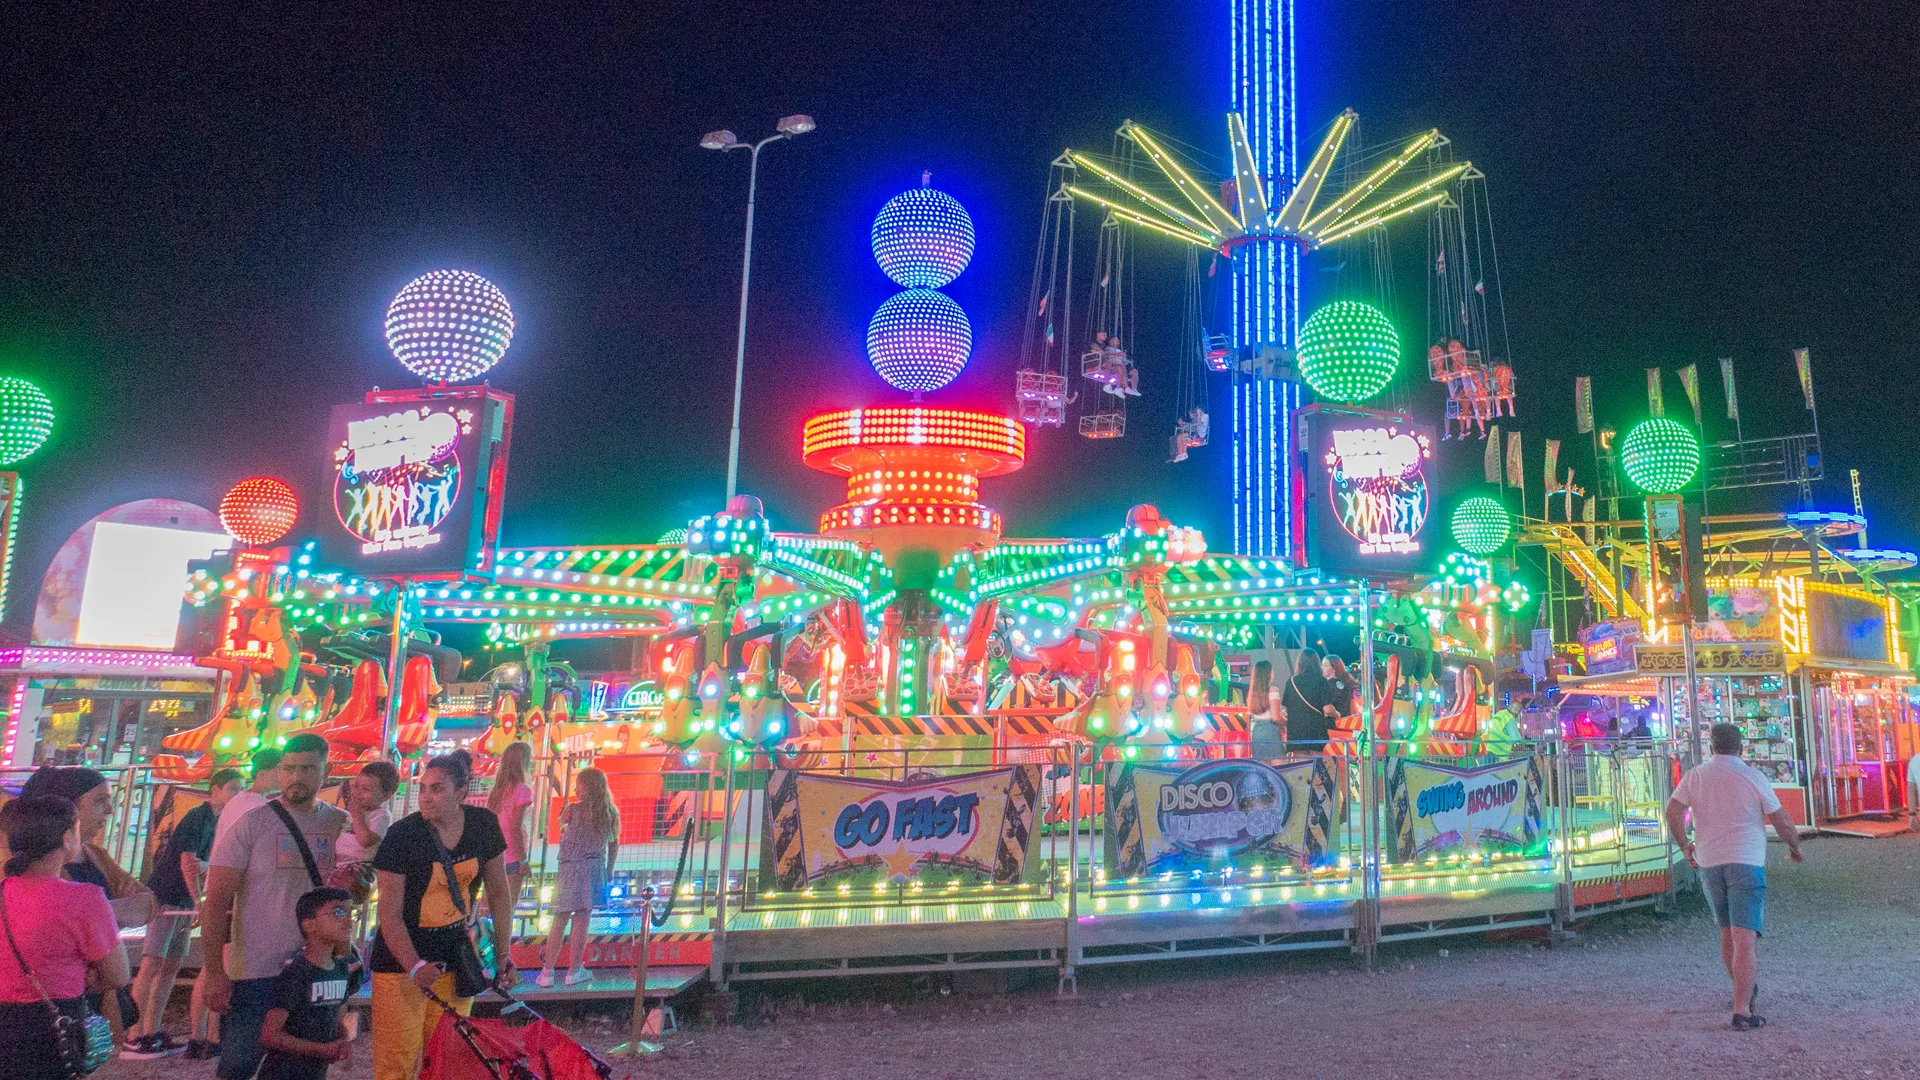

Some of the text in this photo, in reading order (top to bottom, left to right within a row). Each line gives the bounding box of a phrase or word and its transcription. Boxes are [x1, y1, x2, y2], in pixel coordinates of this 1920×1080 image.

[1160, 781, 1235, 812] DISCO
[1416, 778, 1519, 819] SWING AROUND
[833, 792, 979, 849] GO FAST
[1163, 808, 1285, 843] JUMPER
[588, 944, 682, 963] DANER
